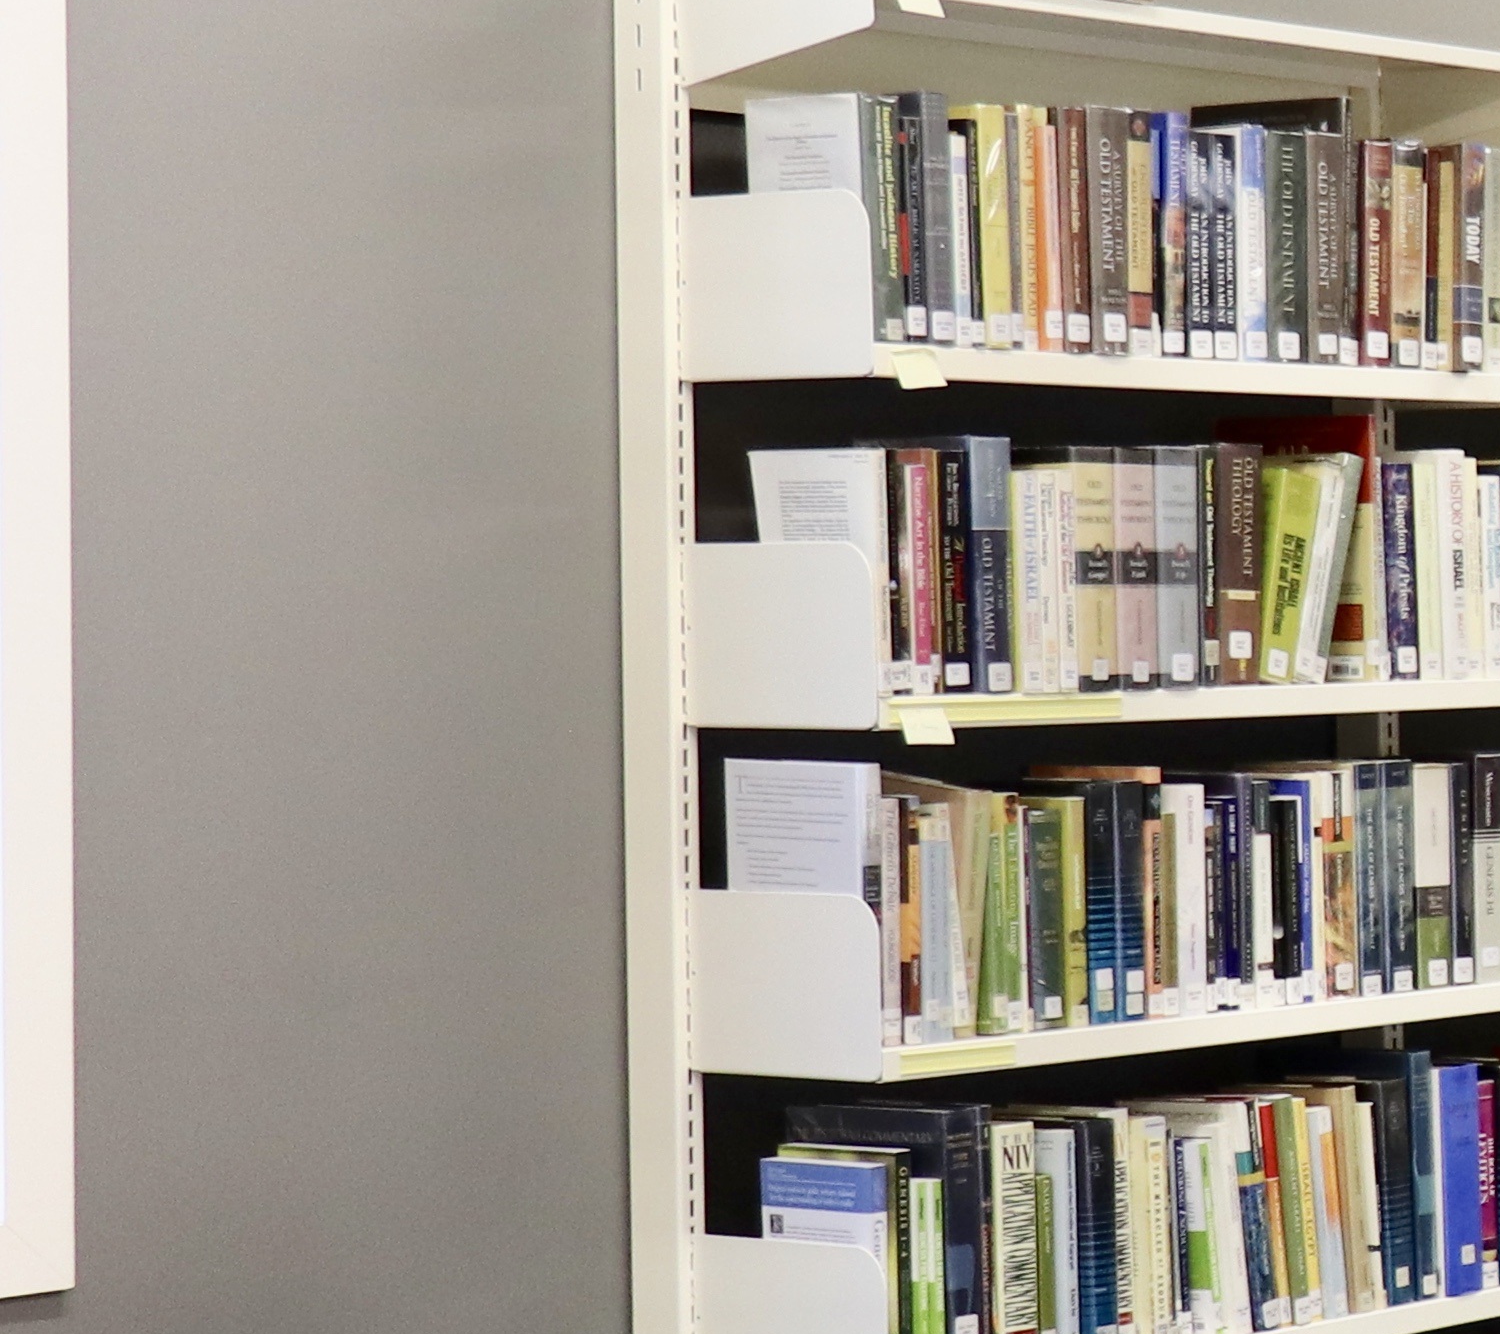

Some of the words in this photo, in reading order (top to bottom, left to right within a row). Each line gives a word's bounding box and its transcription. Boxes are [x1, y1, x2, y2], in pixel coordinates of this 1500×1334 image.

[883, 106, 894, 154] Israelite
[885, 157, 894, 179] and
[1099, 138, 1112, 175] OLD
[1281, 146, 1294, 171] THE
[886, 182, 896, 230] Judaean
[1282, 179, 1294, 220] OLD
[1101, 180, 1114, 273] TESTAMENT
[1369, 218, 1379, 243] OLD
[1466, 217, 1480, 263] TODAY
[887, 233, 899, 280] History
[1281, 224, 1295, 315] TESTAMENT
[1370, 246, 1380, 317] TESTAMENT
[1206, 459, 1215, 484] Toward
[1243, 457, 1253, 489] OLD
[1450, 462, 1461, 473] A
[915, 477, 925, 516] Narrative
[1206, 488, 1214, 503] an
[1207, 506, 1215, 521] Old
[1232, 458, 1243, 536] THEOLOGY
[1451, 477, 1462, 526] HISTORY
[916, 520, 925, 538] Art
[1243, 493, 1253, 577] TESTAMENT
[1394, 494, 1408, 554] Kingdom
[1452, 529, 1463, 547] OF
[916, 539, 925, 549] in
[916, 550, 925, 566] the
[982, 538, 995, 567] OLD
[1207, 524, 1215, 565] Testament
[1396, 555, 1410, 570] of
[916, 568, 926, 590] Bible
[1206, 568, 1215, 607] Theology
[1453, 549, 1464, 591] ISRAEL
[984, 574, 995, 651] TESTAMENT
[1398, 573, 1411, 619] Priests
[1007, 831, 1018, 853] The
[1008, 857, 1019, 917] Liberating
[1007, 920, 1020, 958] Image
[1003, 1145, 1033, 1171] NIV
[1003, 1172, 1035, 1246] APPLICATION
[1005, 1249, 1038, 1328] COMMENTARY
